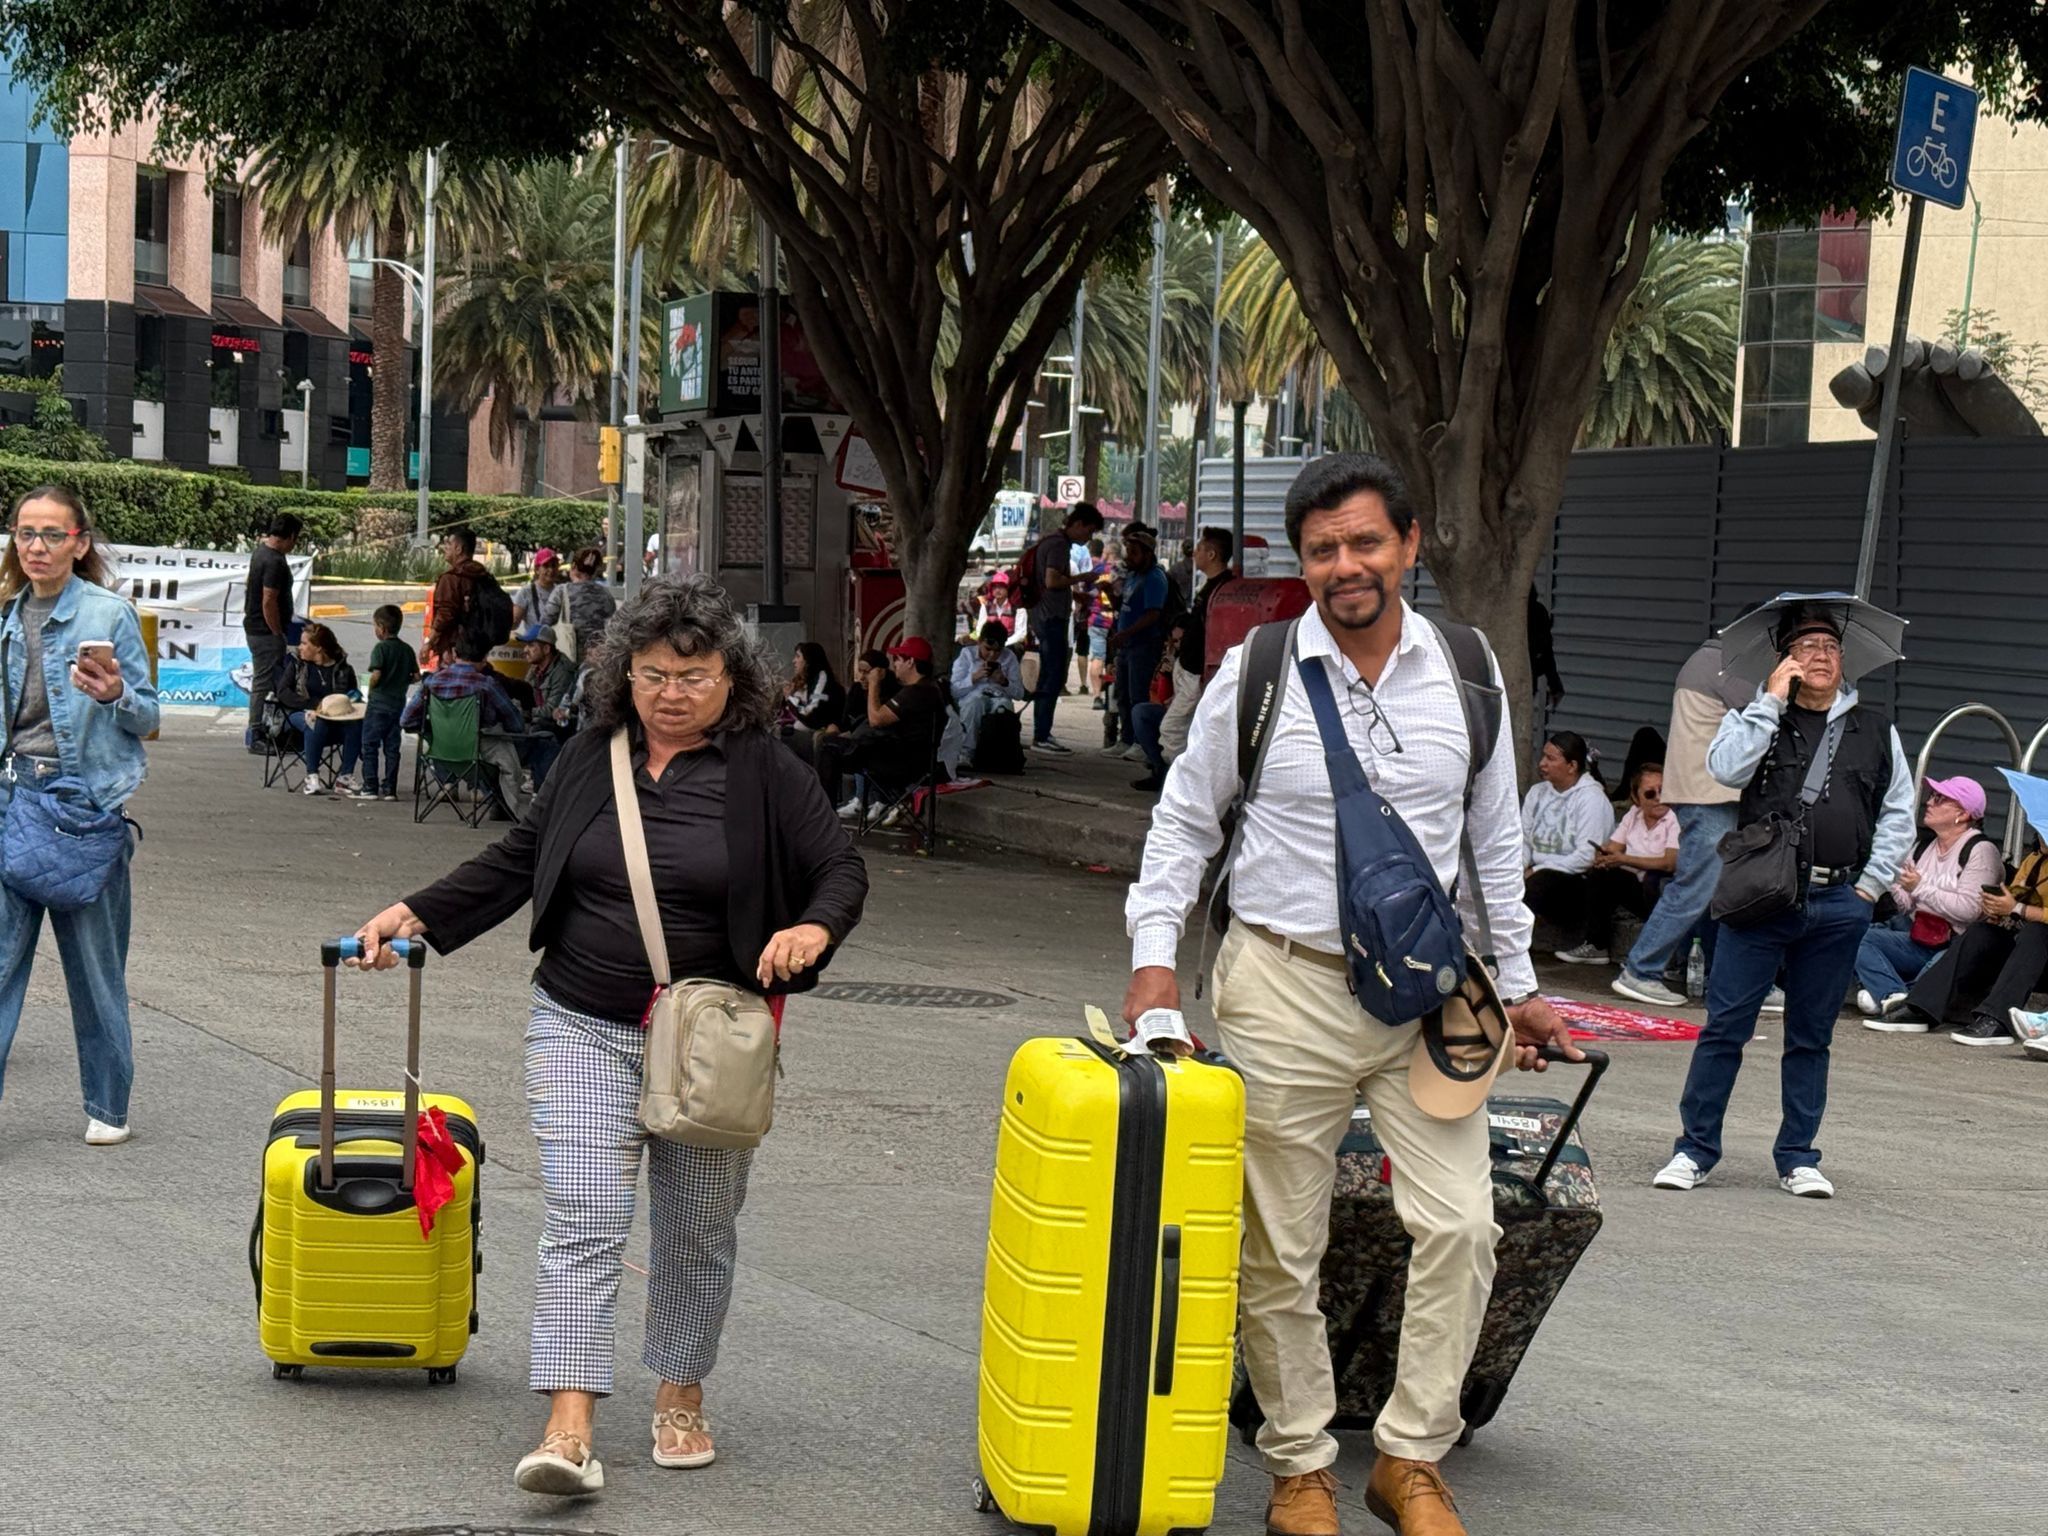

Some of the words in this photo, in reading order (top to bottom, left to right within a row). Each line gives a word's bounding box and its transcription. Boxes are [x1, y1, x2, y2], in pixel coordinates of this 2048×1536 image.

[1930, 91, 1950, 134] E
[728, 366, 739, 376] TU
[1002, 506, 1025, 527] ERUM
[117, 553, 147, 565] de
[155, 555, 177, 567] la
[1496, 1116, 1535, 1129] 18541
